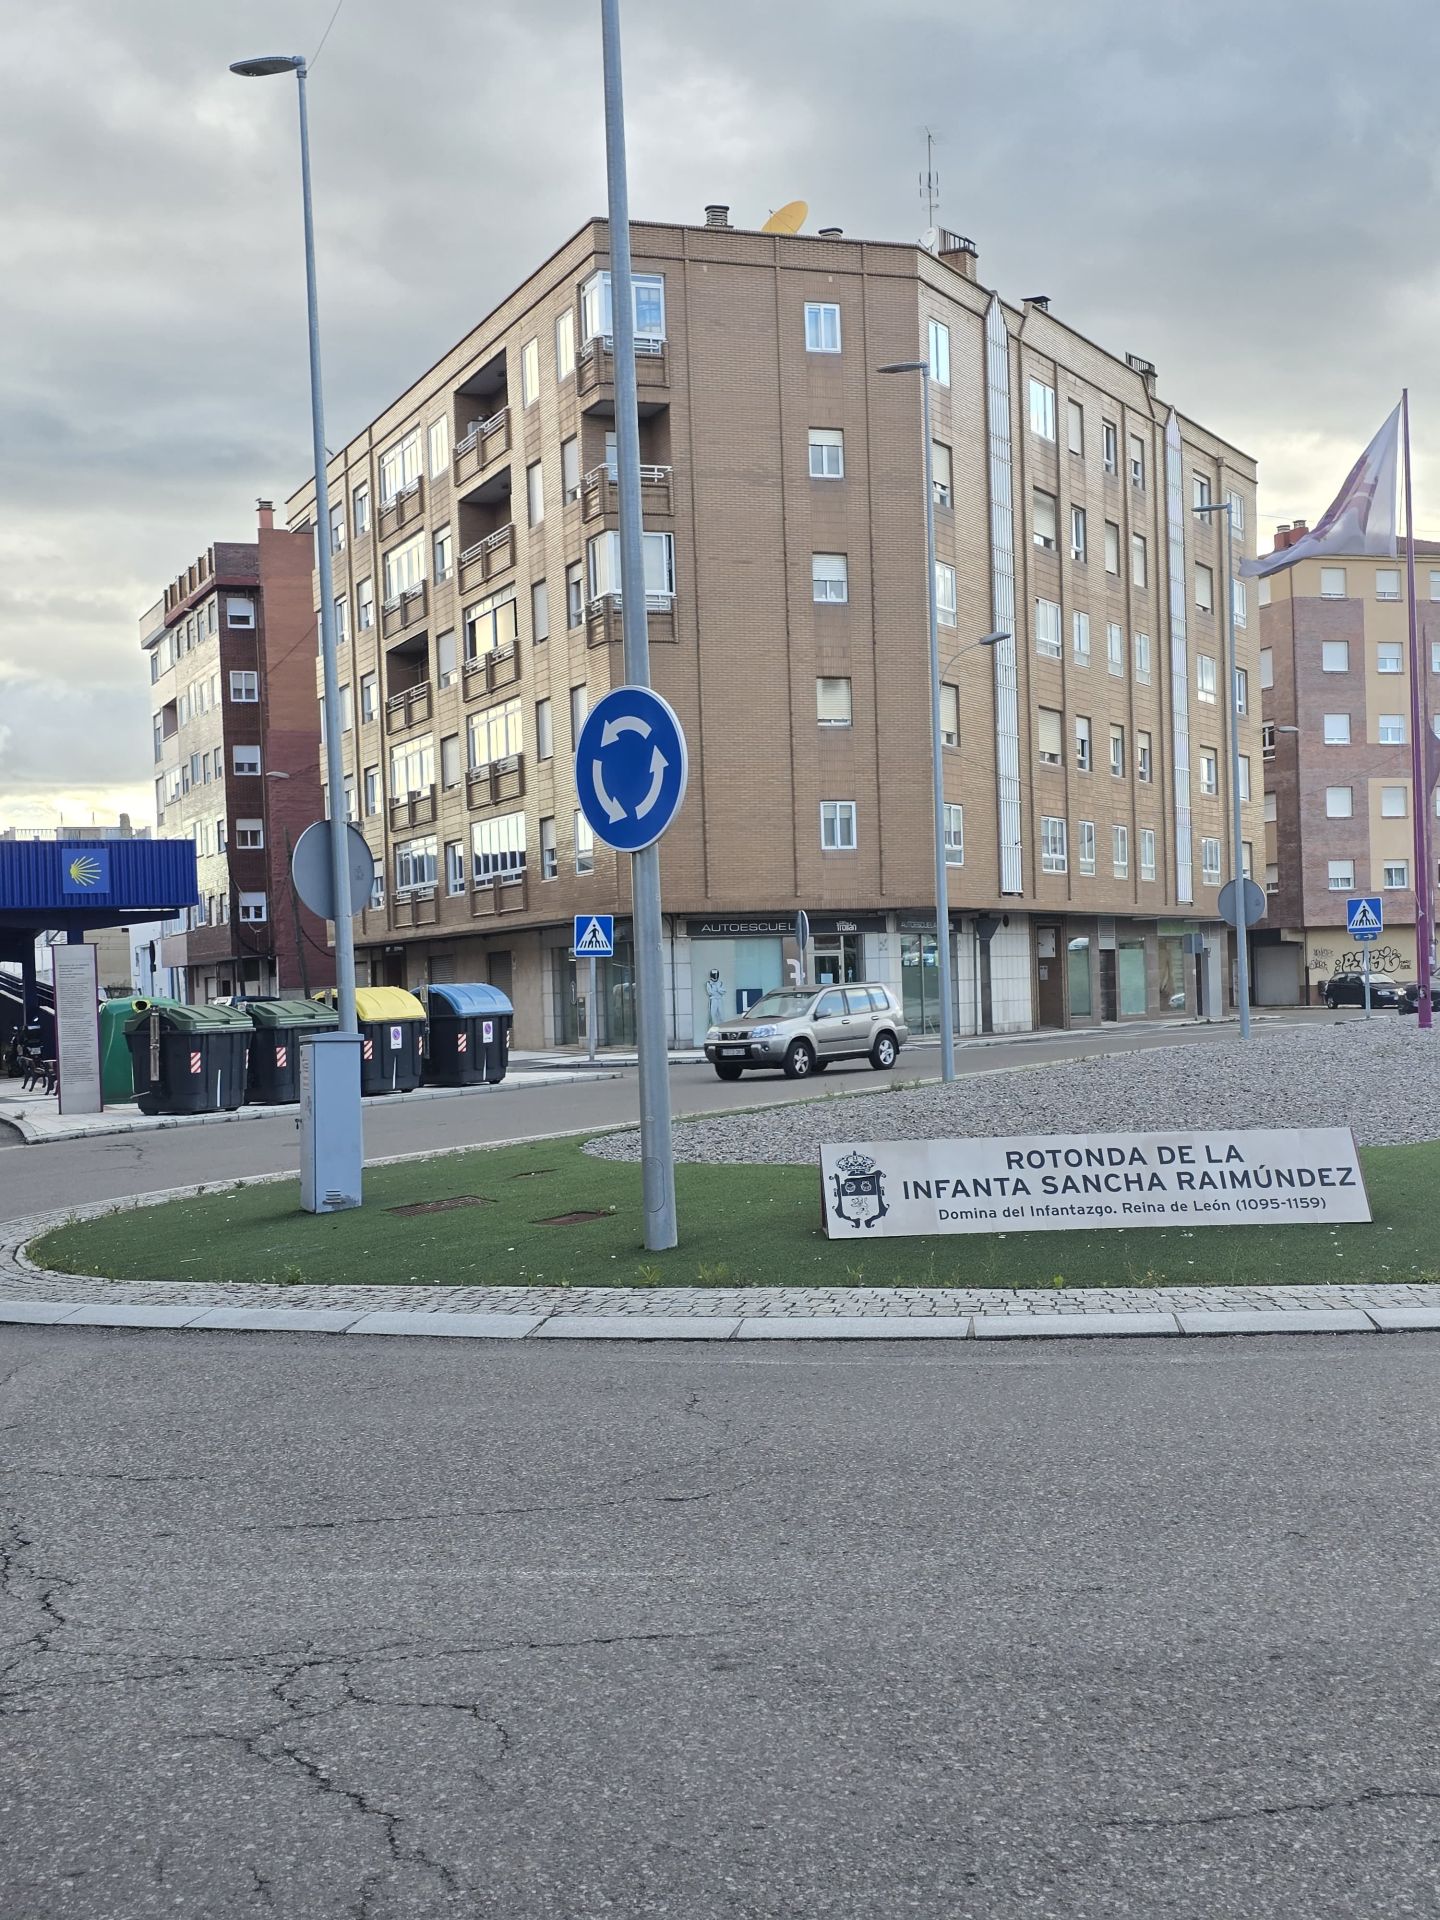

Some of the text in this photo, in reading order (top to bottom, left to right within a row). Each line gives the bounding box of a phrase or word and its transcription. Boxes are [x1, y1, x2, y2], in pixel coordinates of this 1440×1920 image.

[701, 922, 796, 932] AUTOESCUEL
[1005, 1144, 1244, 1170] ROTONDA DE LA
[903, 1164, 1356, 1199] INFANTA SANCHA RAIMÚNDEZ
[938, 1197, 1327, 1220] Domina del Infantazgo. Reina de León (1095-1159)
